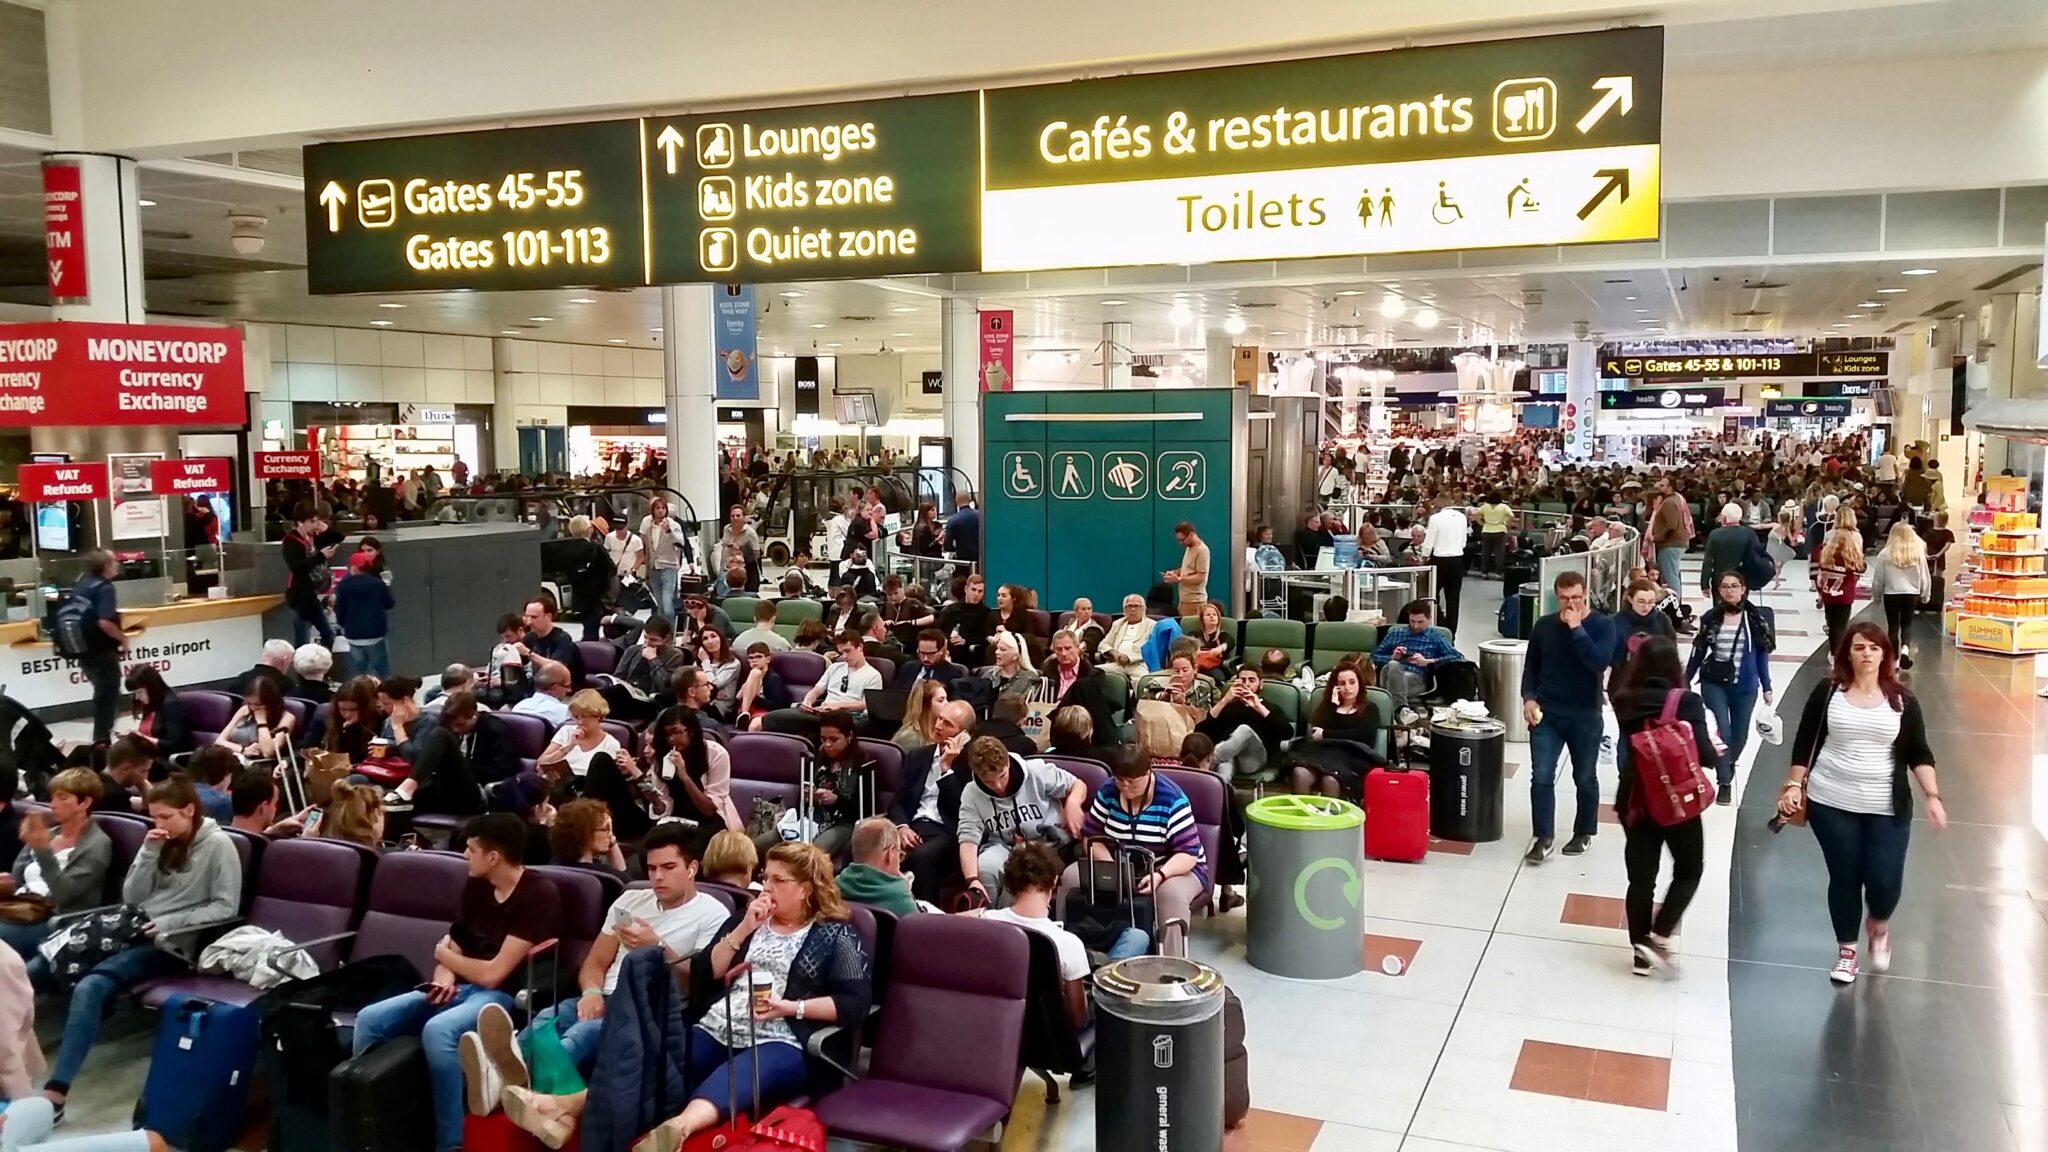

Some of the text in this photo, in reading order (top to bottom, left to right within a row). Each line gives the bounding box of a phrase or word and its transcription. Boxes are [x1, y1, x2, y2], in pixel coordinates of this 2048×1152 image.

[1039, 92, 1474, 163] Cafés & restaurants
[742, 121, 877, 160] Lounges
[404, 169, 583, 214] Gates 45-55
[745, 171, 894, 209] Kids zone
[1177, 189, 1327, 233] Toilets
[406, 226, 610, 271] Gates 101-113
[747, 226, 917, 264] Quiet zone
[87, 338, 227, 363] MONEYCORP
[1844, 356, 1877, 364] Lounges
[1645, 358, 1781, 372] Gates 45-55 & 101-113
[119, 369, 203, 390] Currency
[118, 392, 207, 413] Exchange
[183, 464, 205, 475] VAT
[263, 454, 309, 465] Currency
[263, 464, 311, 474] Exchange
[55, 469, 80, 481] VAT
[173, 476, 217, 489] Refunds
[43, 483, 93, 496] Refunds
[1968, 625, 2003, 636] SUMMER
[21, 658, 61, 675] BEST
[136, 645, 159, 659] the
[162, 638, 211, 656] airport
[1460, 775, 1468, 798] general
[985, 804, 1043, 833] OXFORD
[1156, 1086, 1170, 1127] general
